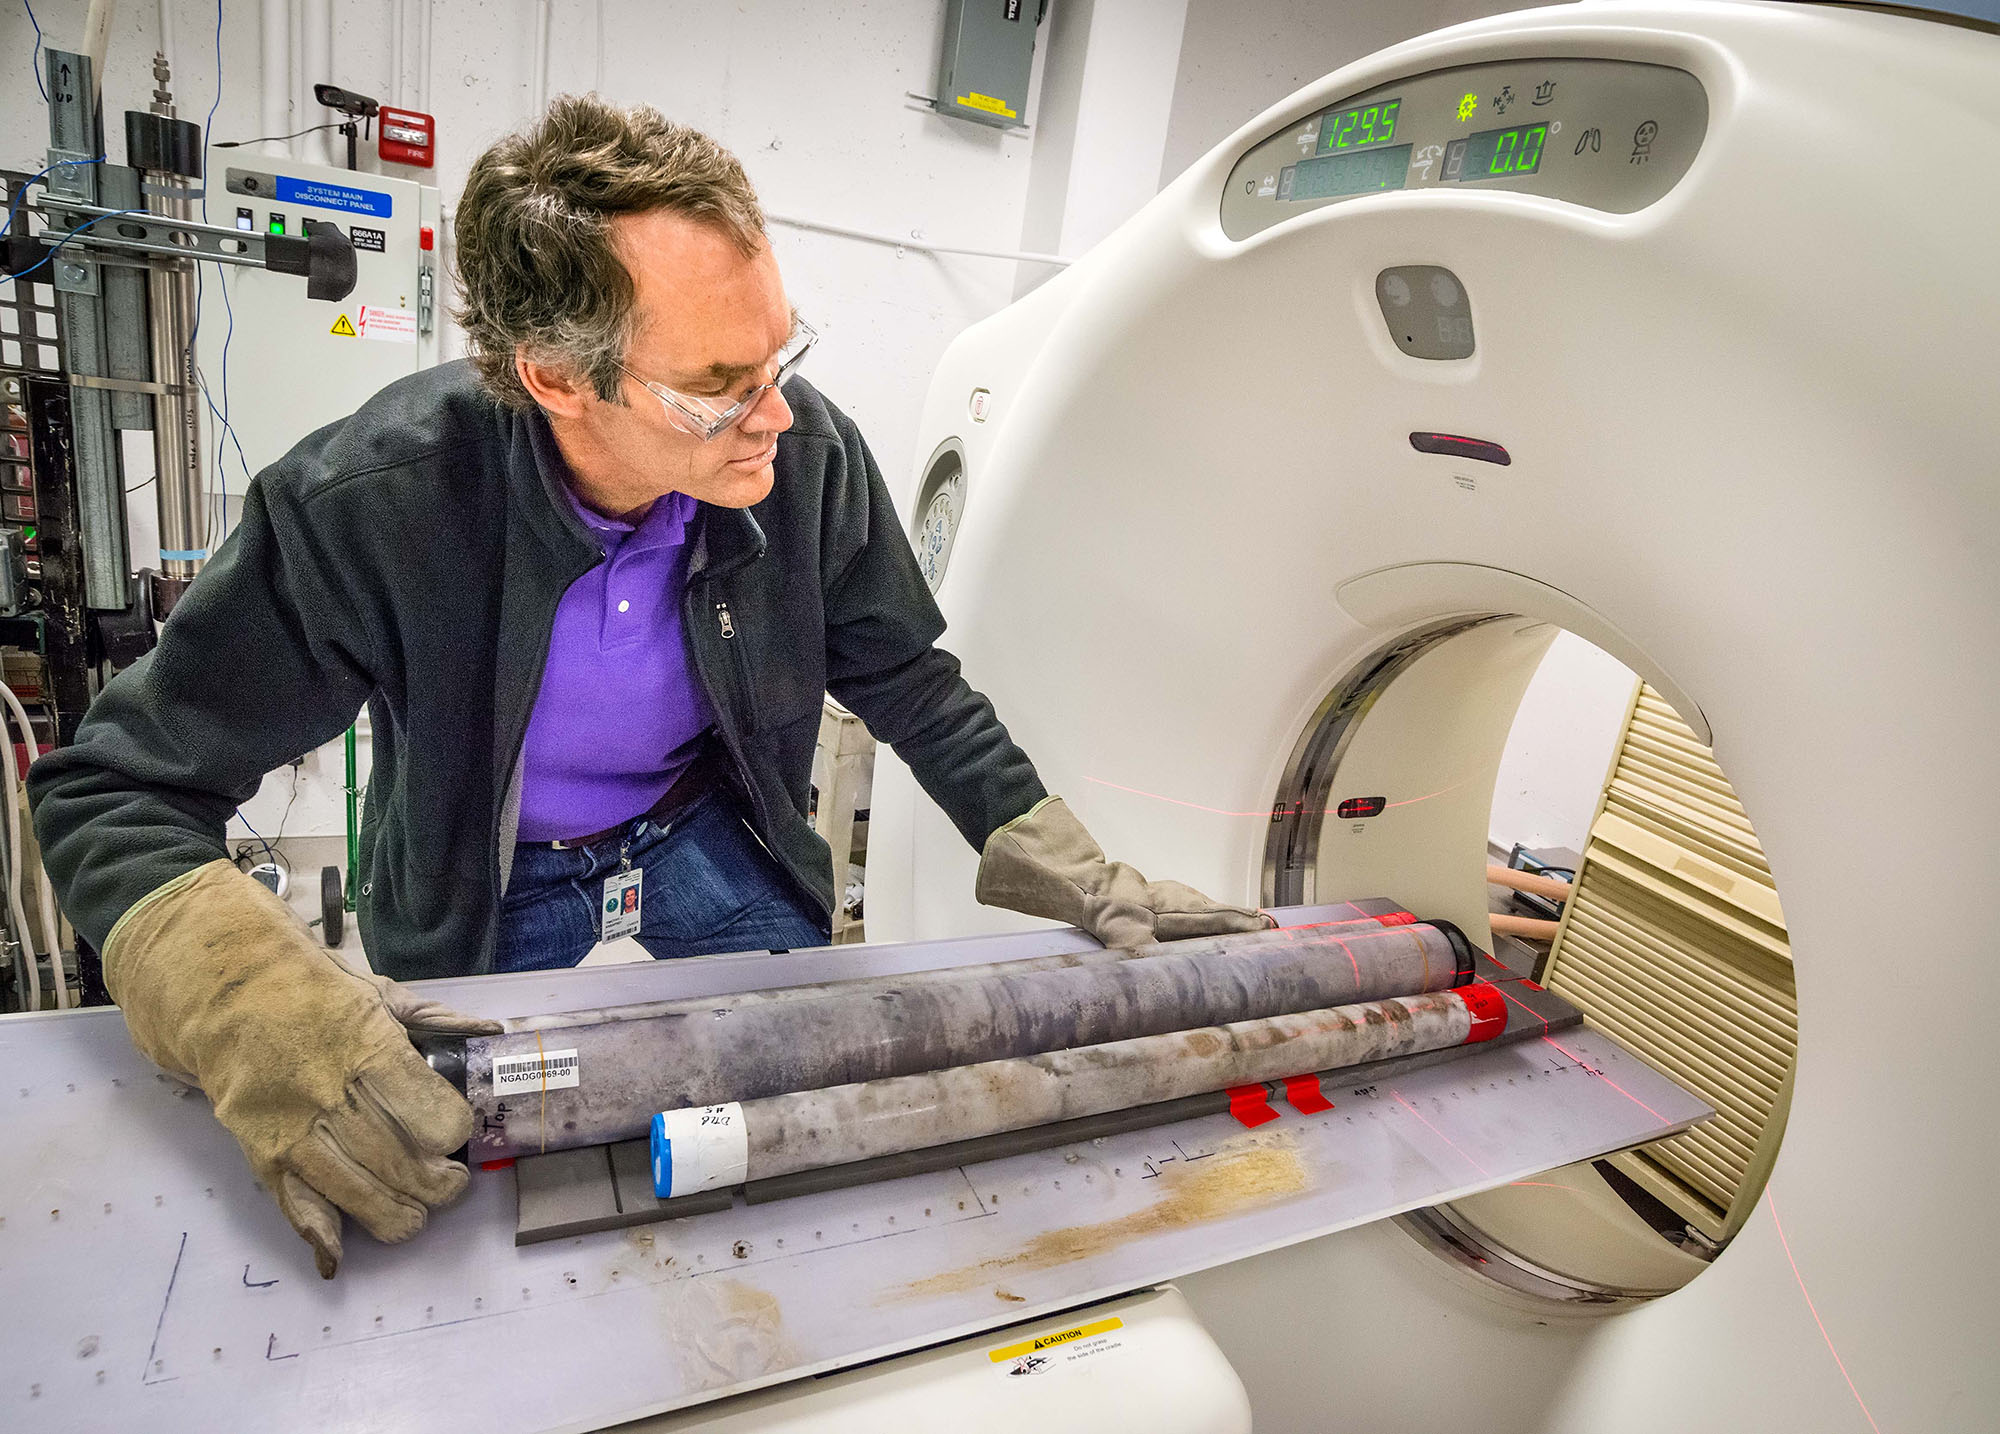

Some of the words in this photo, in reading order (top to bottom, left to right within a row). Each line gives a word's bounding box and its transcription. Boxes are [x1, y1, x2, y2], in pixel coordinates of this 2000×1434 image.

[55, 92, 73, 103] UP
[1328, 103, 1399, 149] 129.5
[407, 148, 425, 159] FIRE
[1489, 127, 1546, 173] 0.0
[294, 192, 348, 206] DISCONNECT
[349, 201, 375, 211] PANEL
[307, 186, 340, 197] SYSTEM
[342, 192, 363, 201] MAIN
[482, 1102, 513, 1133] Top
[1043, 1329, 1082, 1345] CAUTION
